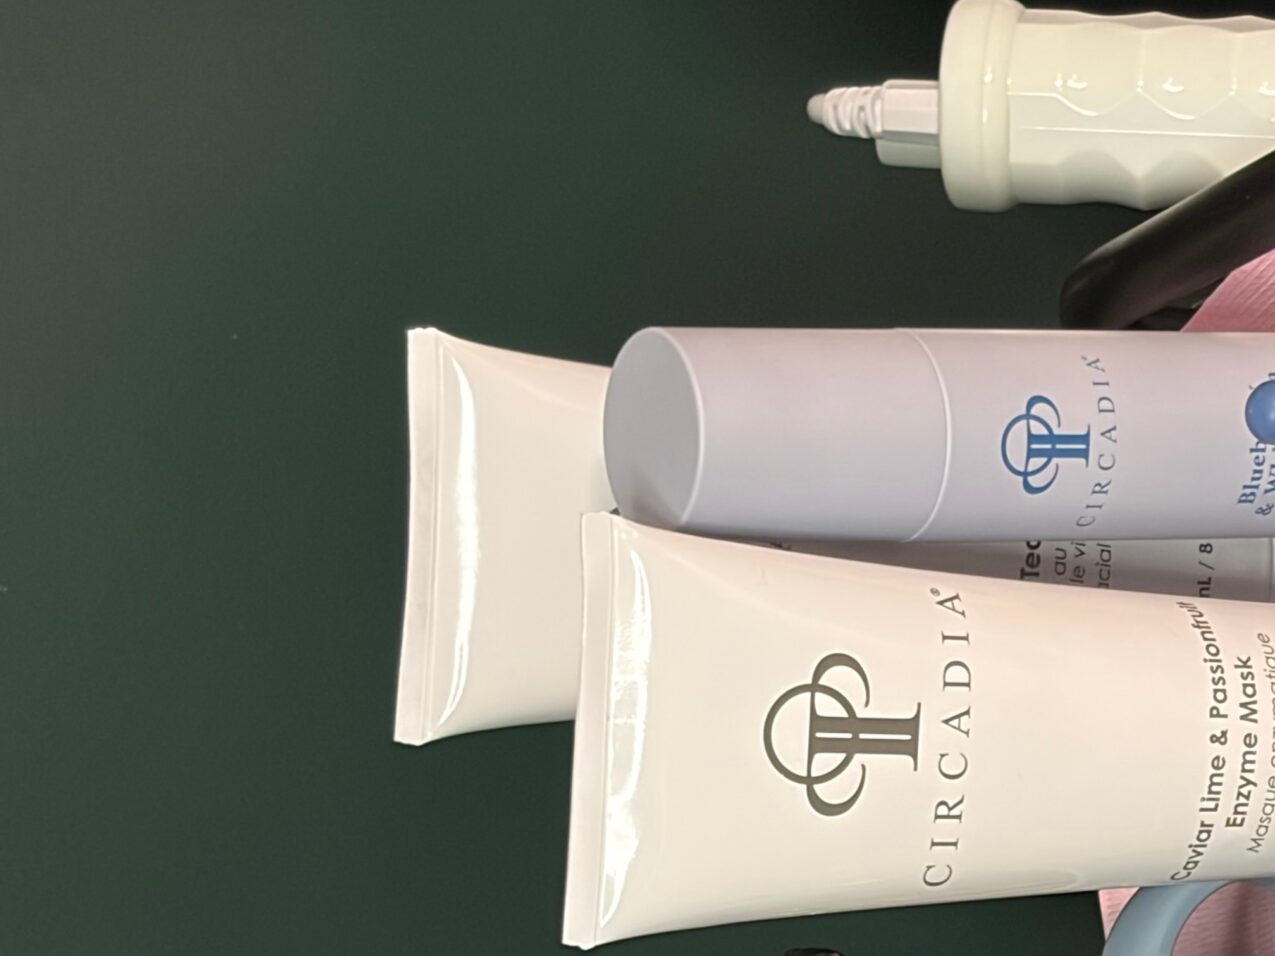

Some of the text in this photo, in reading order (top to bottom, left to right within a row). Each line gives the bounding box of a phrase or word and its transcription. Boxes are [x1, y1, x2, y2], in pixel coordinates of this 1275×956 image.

[1254, 502, 1275, 516] &
[1198, 543, 1213, 554] 8
[1054, 547, 1067, 576] au
[1069, 565, 1086, 584] le
[1169, 601, 1229, 881] Caviar Lime & Passionfruit
[1225, 656, 1258, 828] Enzyme Mask
